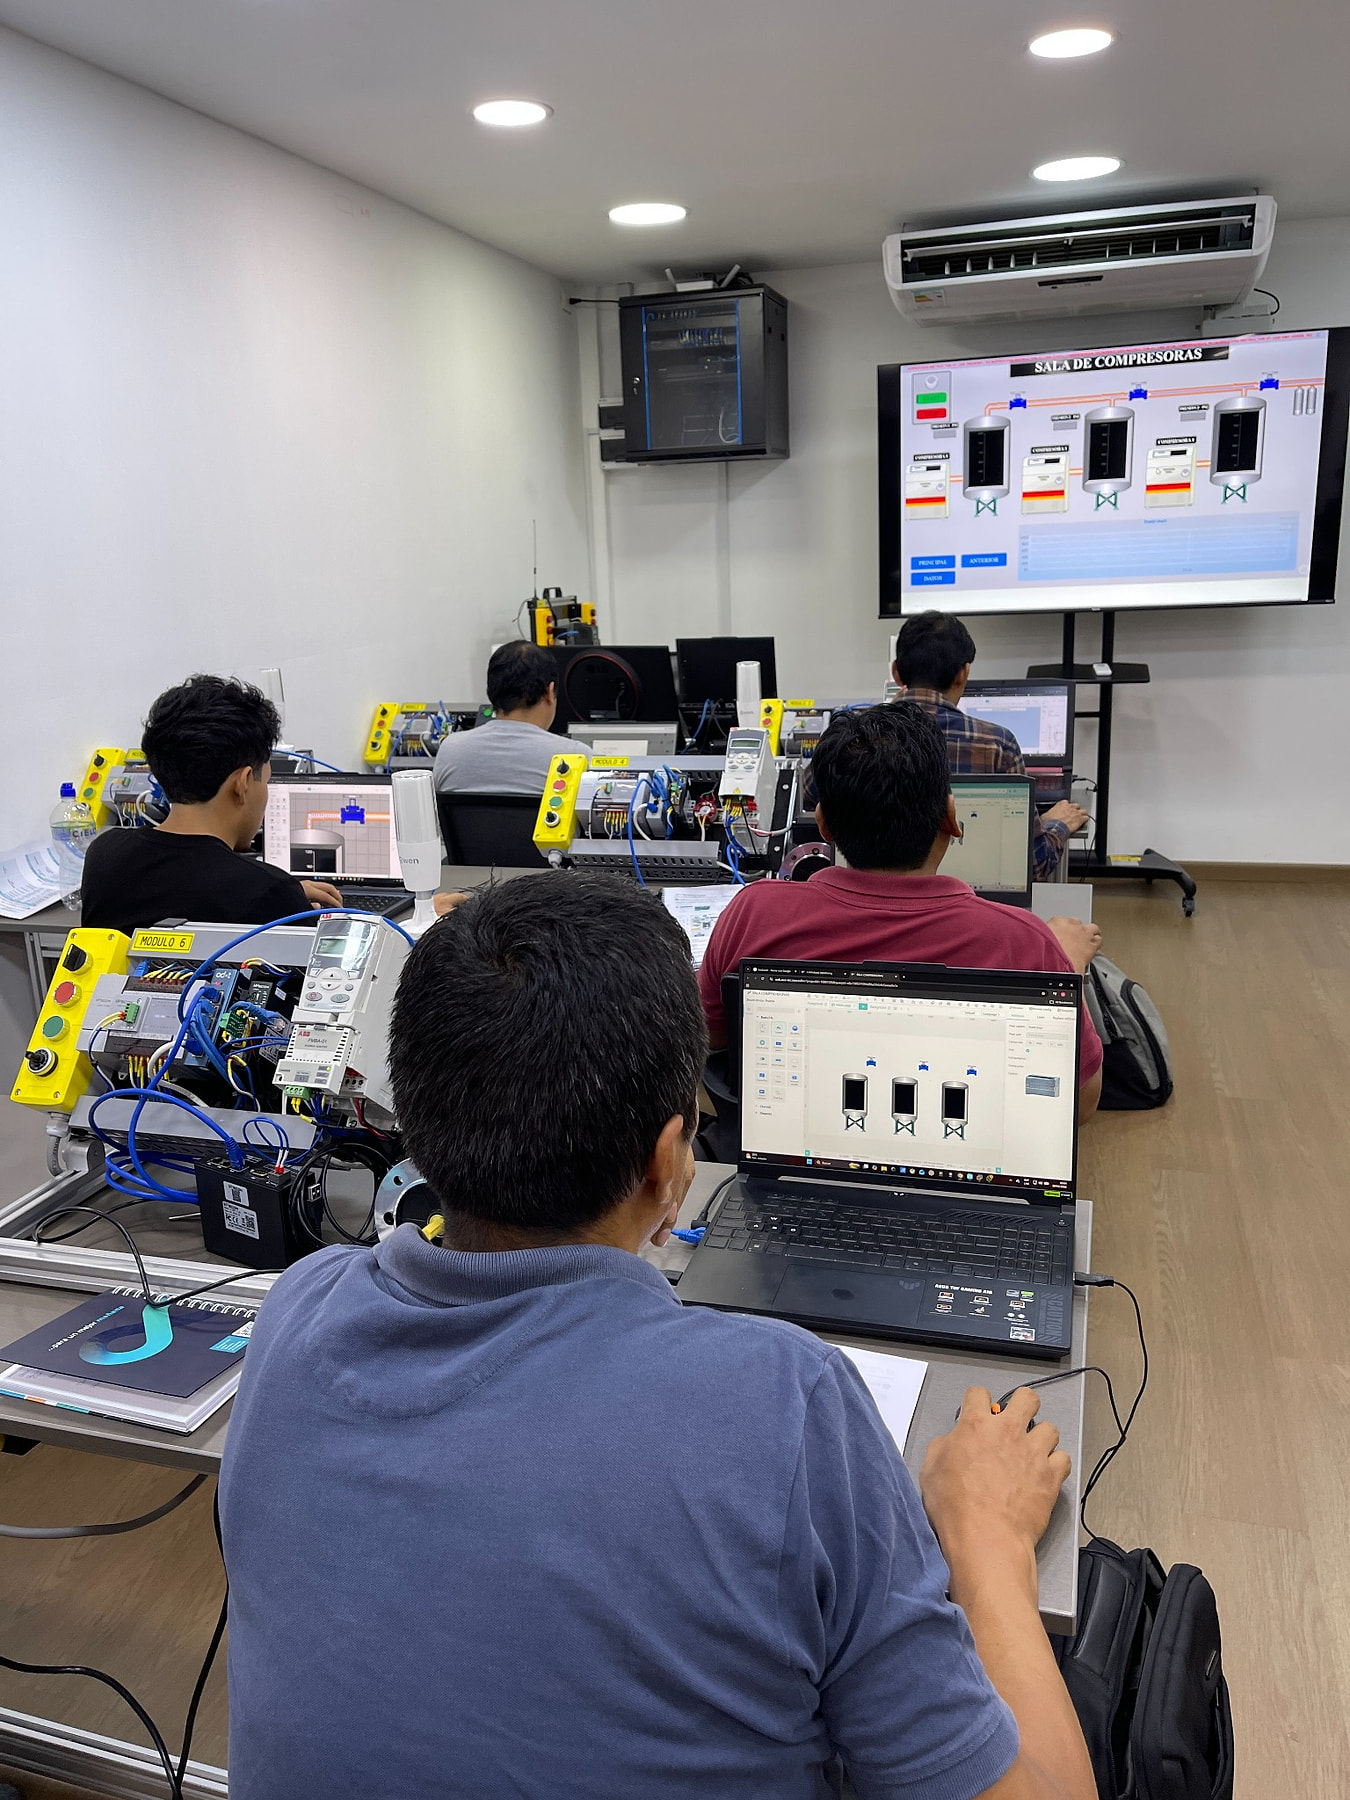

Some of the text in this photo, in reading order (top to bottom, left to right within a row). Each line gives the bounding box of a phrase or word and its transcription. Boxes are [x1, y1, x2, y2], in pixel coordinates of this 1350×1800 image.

[1035, 359, 1071, 374] SALA
[1073, 357, 1092, 370] DE
[1094, 348, 1203, 368] COMPRESORAS
[140, 935, 187, 948] MODULO 6
[1045, 1300, 1063, 1336] CAUTION
